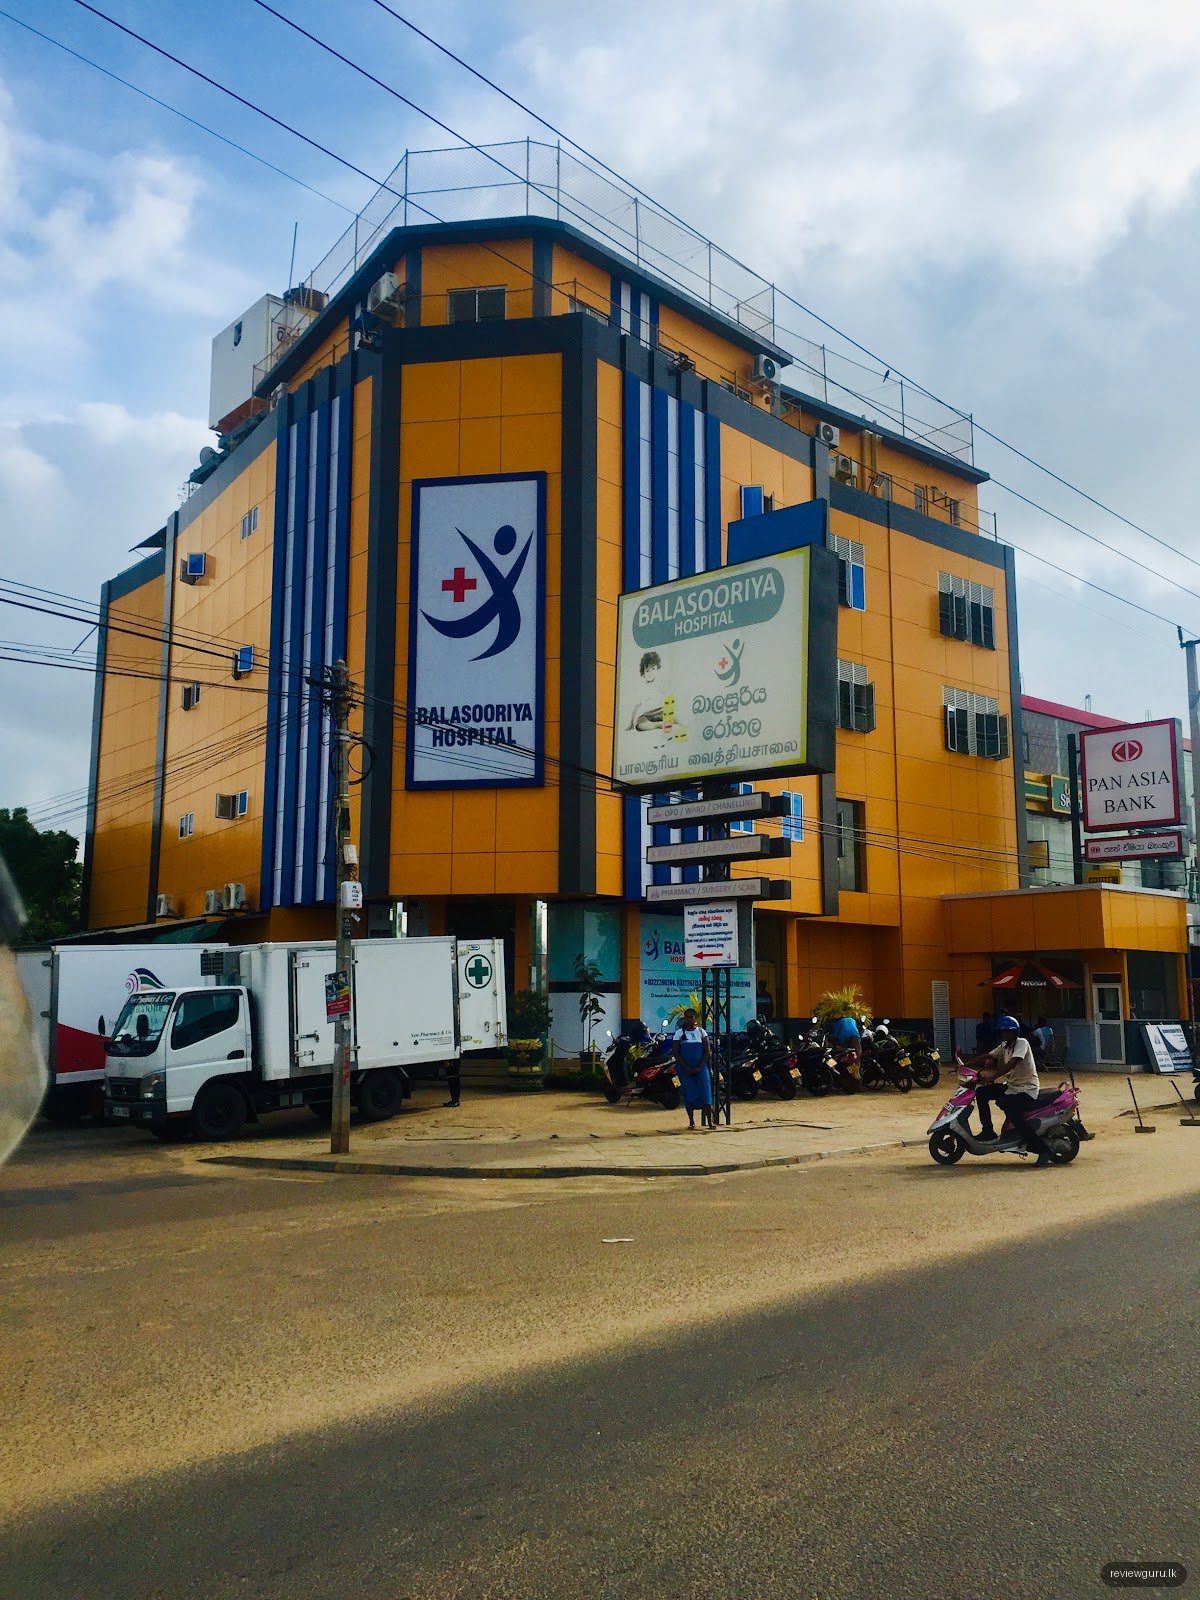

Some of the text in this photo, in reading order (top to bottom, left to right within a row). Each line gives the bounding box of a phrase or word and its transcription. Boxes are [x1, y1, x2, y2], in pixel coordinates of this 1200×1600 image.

[638, 572, 777, 627] BALASOORIYA
[674, 609, 735, 637] HOSPITAL
[417, 703, 533, 724] BALASOORIYA
[432, 727, 516, 747] HOSPITAL
[702, 715, 761, 741] රෝහල
[1088, 770, 1171, 792] PAN ASIA
[1104, 795, 1157, 813] BANK
